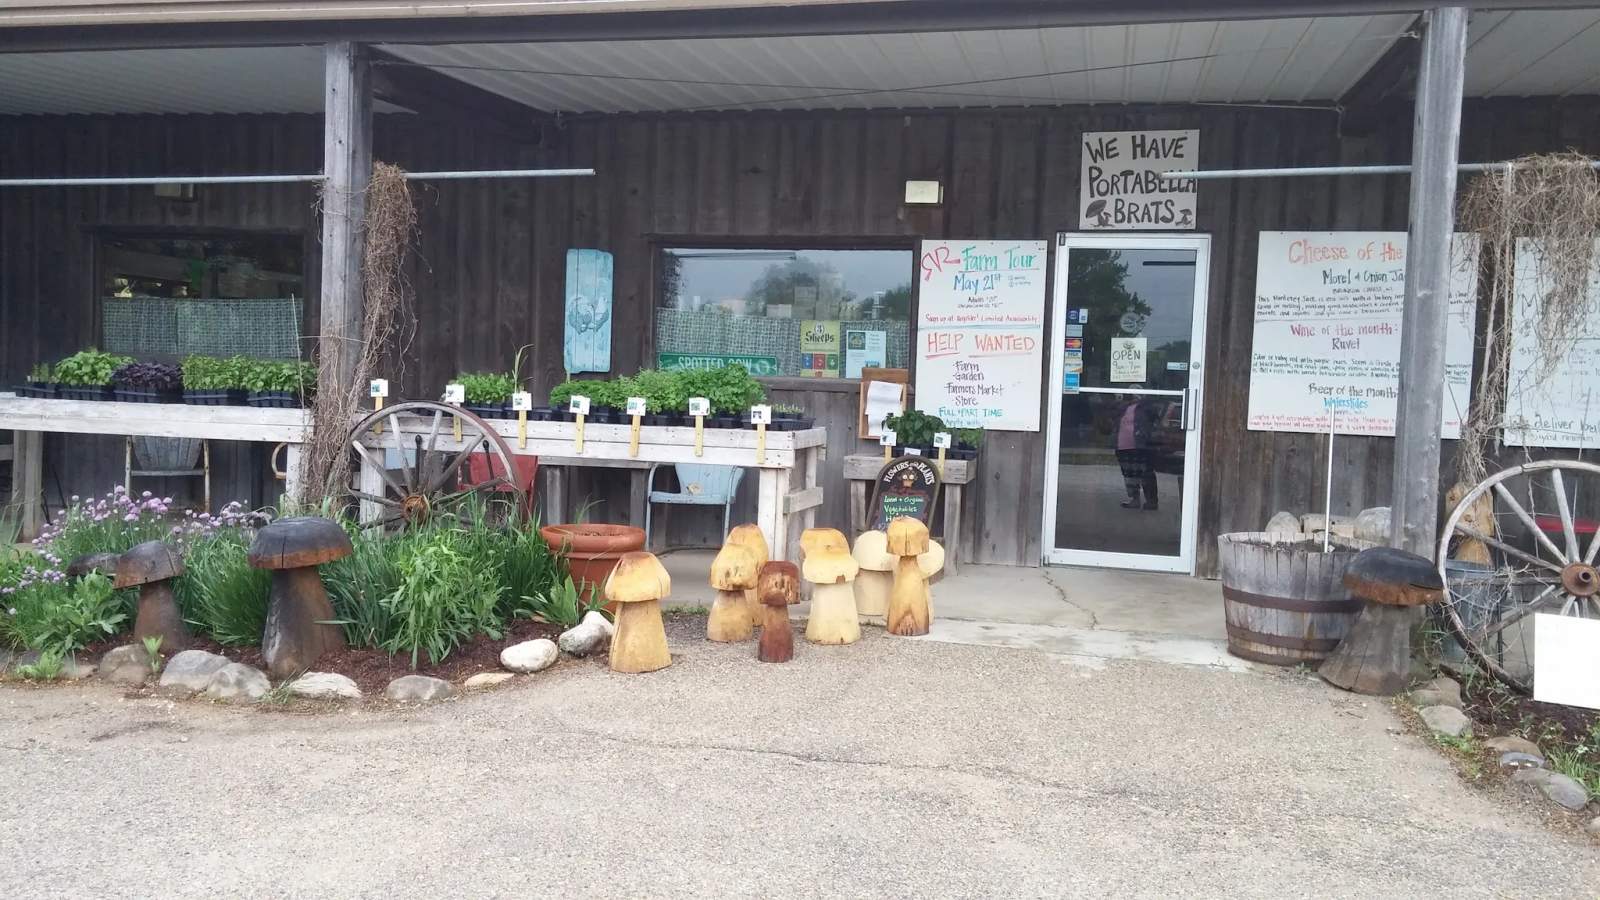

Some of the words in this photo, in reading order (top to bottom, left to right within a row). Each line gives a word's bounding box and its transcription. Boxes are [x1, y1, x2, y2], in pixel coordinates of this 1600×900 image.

[1085, 138, 1120, 163] WE
[1131, 134, 1188, 160] HAVE
[1088, 166, 1197, 198] PORTABELLA
[1114, 198, 1175, 224] BRATS
[962, 245, 998, 271] Farm
[1004, 245, 1037, 269] Tour
[1288, 239, 1348, 263] Cheese
[1357, 241, 1375, 261] of
[1380, 241, 1404, 262] the
[953, 273, 979, 295] May
[1322, 268, 1352, 285] Morel
[1363, 270, 1388, 284] Onion
[804, 331, 834, 345] Sheeps
[1290, 325, 1315, 336] Wine
[1322, 324, 1331, 336] of
[1335, 323, 1353, 336] the
[927, 332, 964, 353] HELP
[975, 334, 1035, 352] WANTED
[1112, 350, 1141, 360] OPEN
[977, 384, 1004, 396] Market
[1308, 383, 1334, 395] Beer
[1336, 385, 1345, 395] of
[1349, 384, 1364, 397] the
[983, 408, 1003, 418] TIME
[1534, 413, 1574, 430] deliver
[884, 461, 910, 483] FLOWERS
[918, 462, 935, 485] PLANTS
